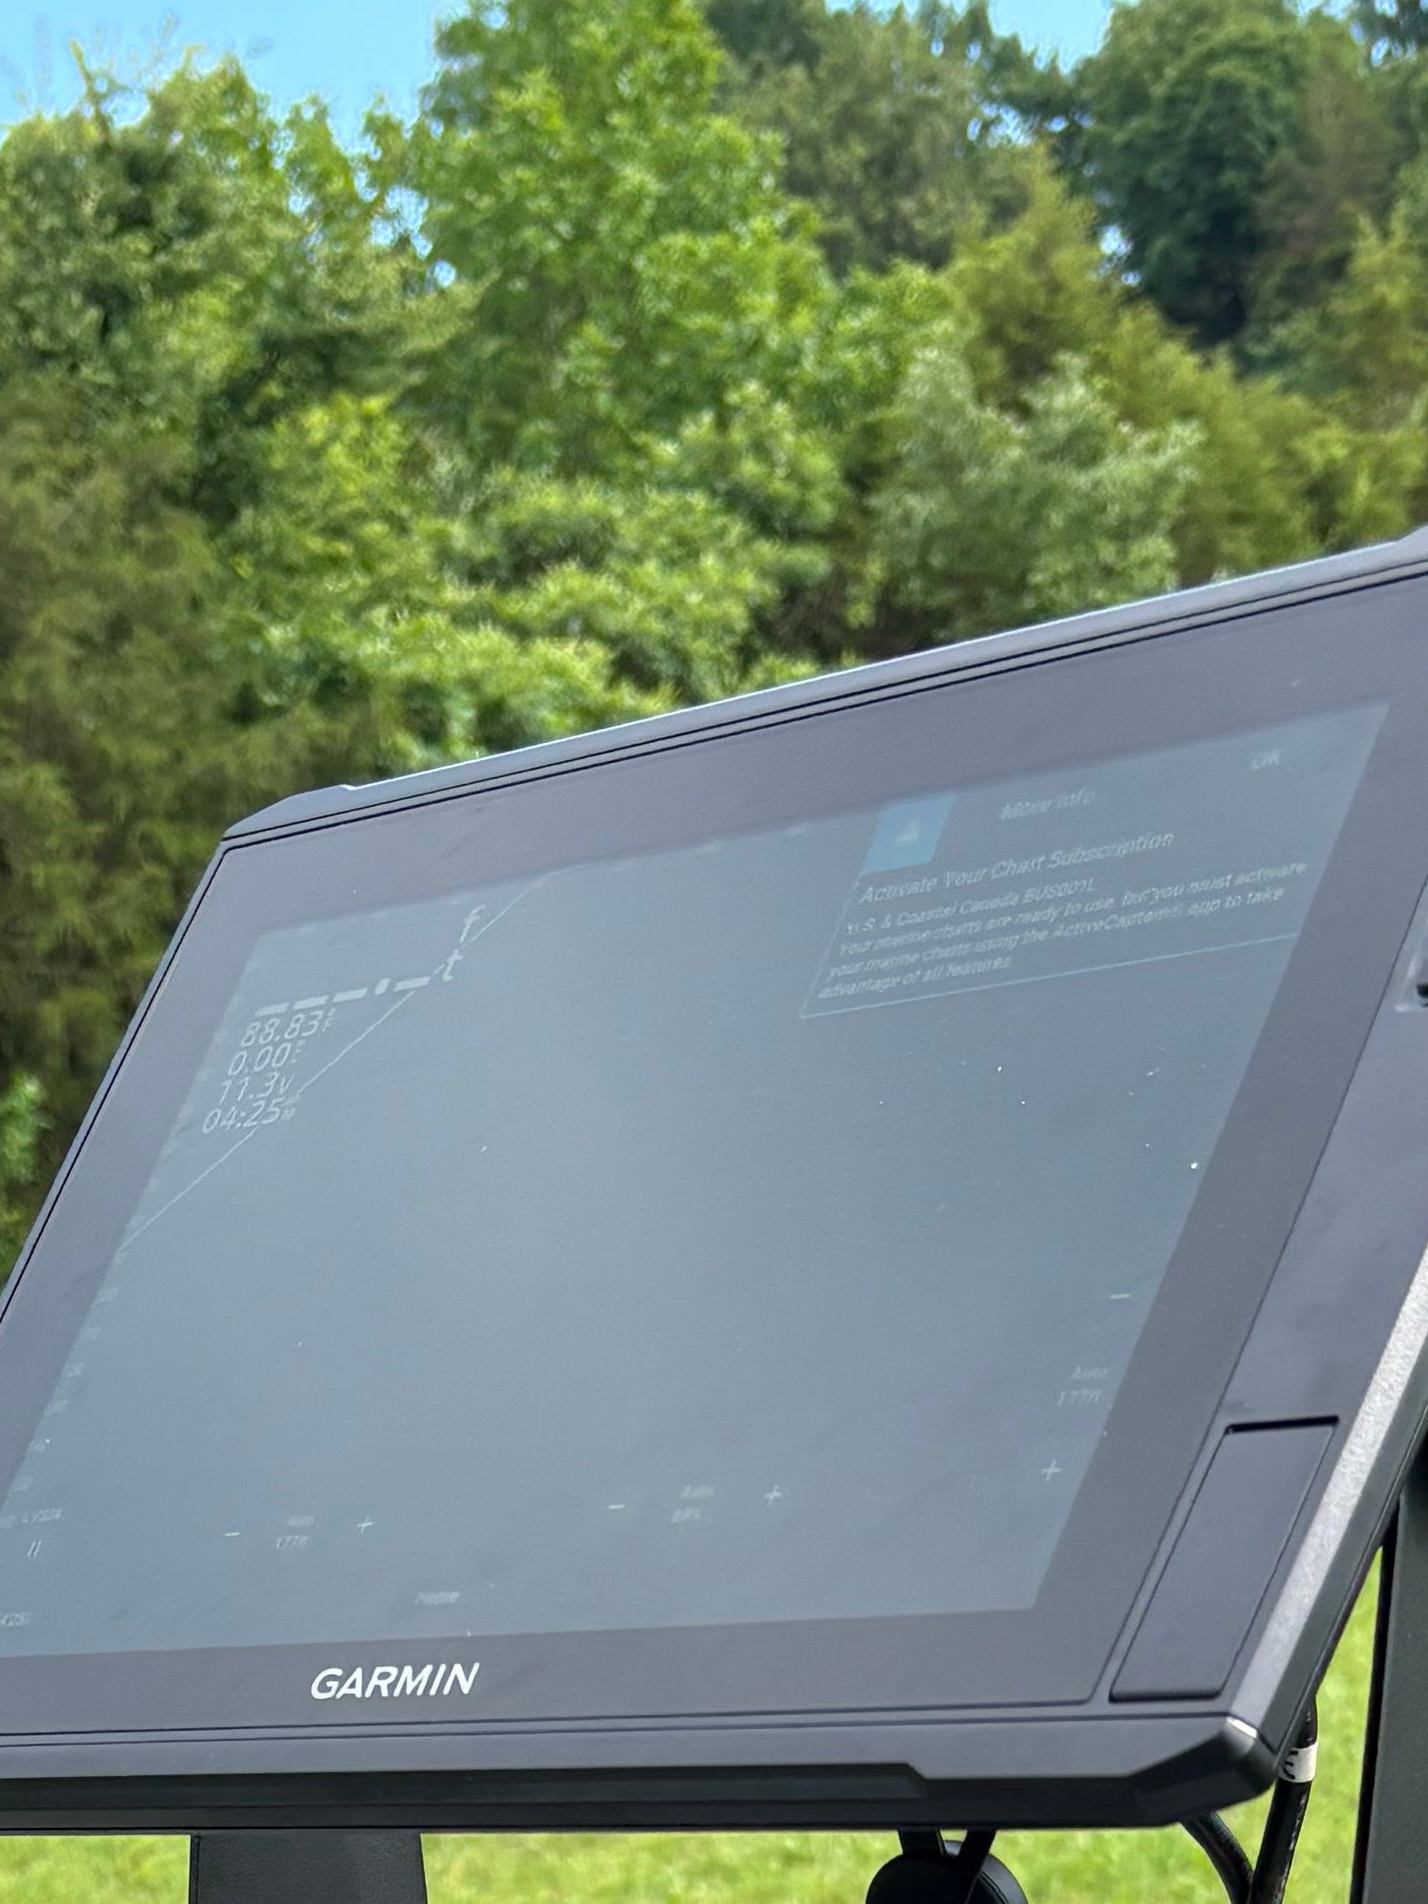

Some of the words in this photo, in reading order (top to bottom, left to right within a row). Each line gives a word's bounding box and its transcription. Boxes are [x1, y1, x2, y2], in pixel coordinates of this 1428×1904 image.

[1248, 748, 1284, 769] OK
[859, 874, 939, 903] Activate
[941, 865, 989, 888] Your
[988, 854, 1046, 879] Chart
[1045, 828, 1176, 871] Subscription
[1062, 901, 1083, 916] to
[1187, 875, 1233, 894] must
[1234, 861, 1308, 885] activate
[1244, 886, 1286, 905] take
[815, 976, 901, 1002] advantage
[240, 1010, 325, 1048] 88.83
[227, 1043, 292, 1077] 0.00
[201, 1096, 286, 1134] 04:25
[310, 1662, 479, 1700] GARMIN
